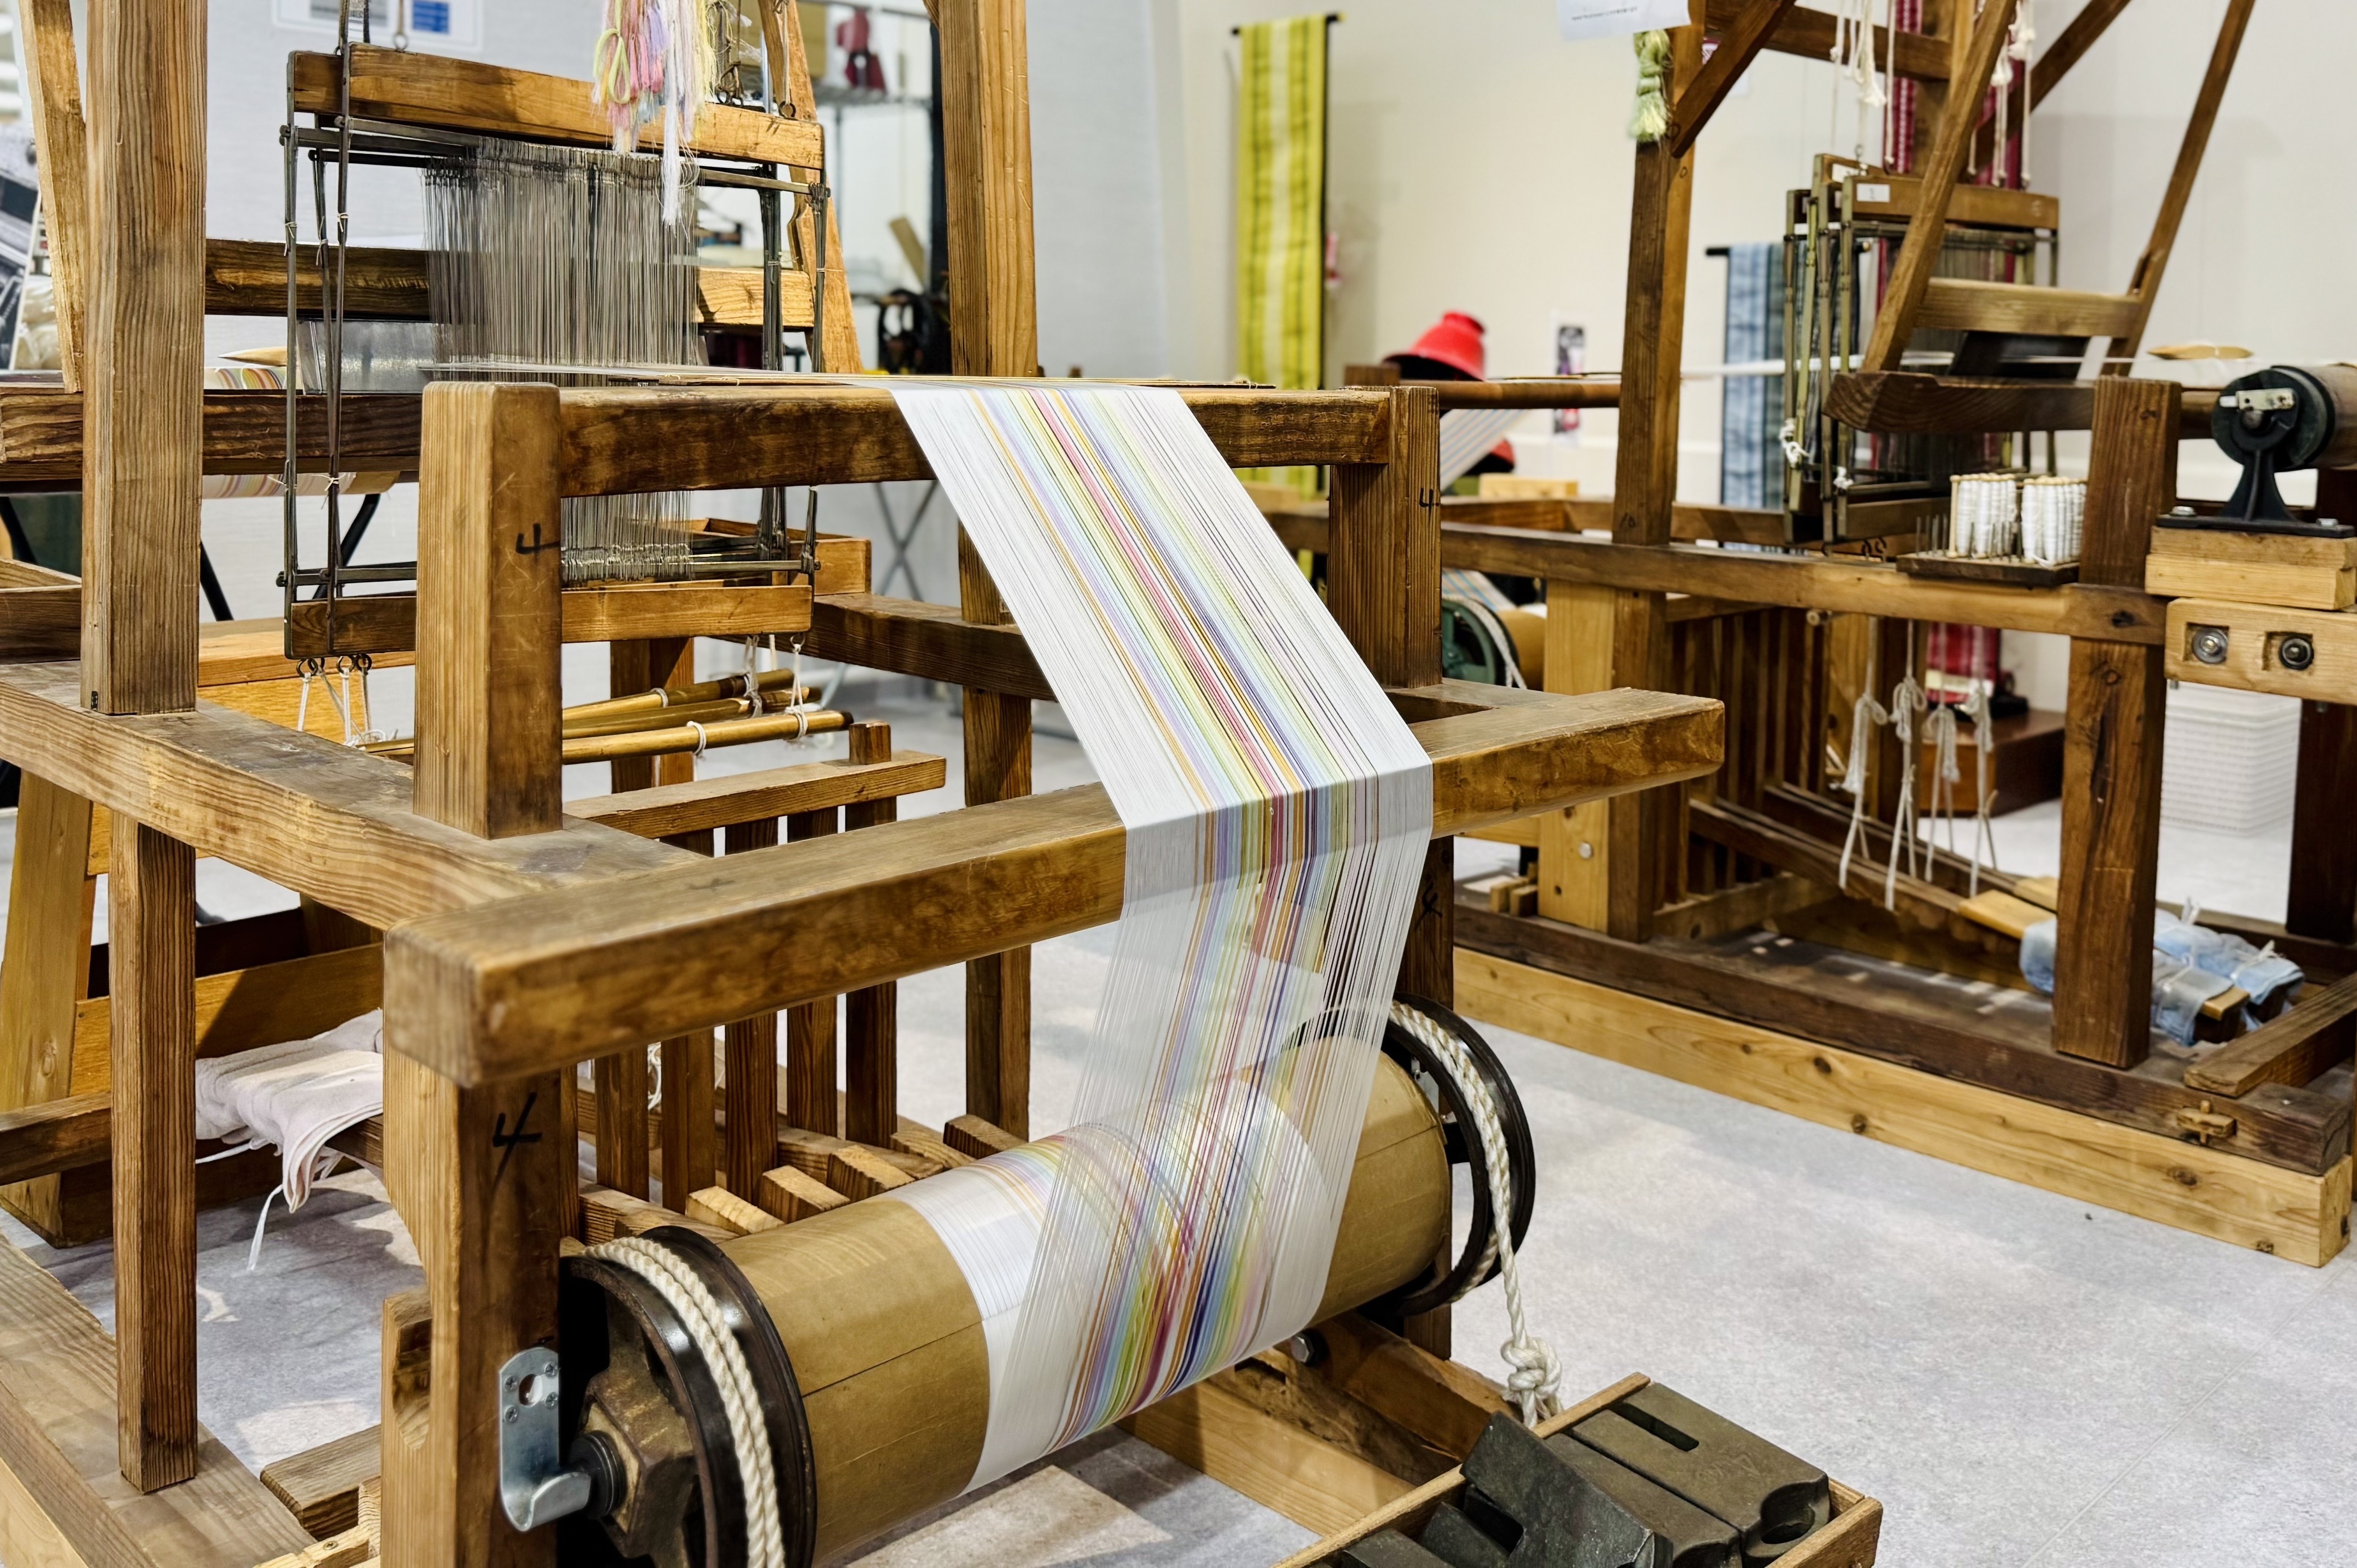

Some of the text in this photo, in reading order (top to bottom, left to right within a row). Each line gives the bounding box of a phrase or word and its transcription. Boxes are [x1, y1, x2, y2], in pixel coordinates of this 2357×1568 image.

[1419, 487, 1439, 516] 4
[515, 522, 560, 565] 4
[492, 1092, 543, 1192] 4
